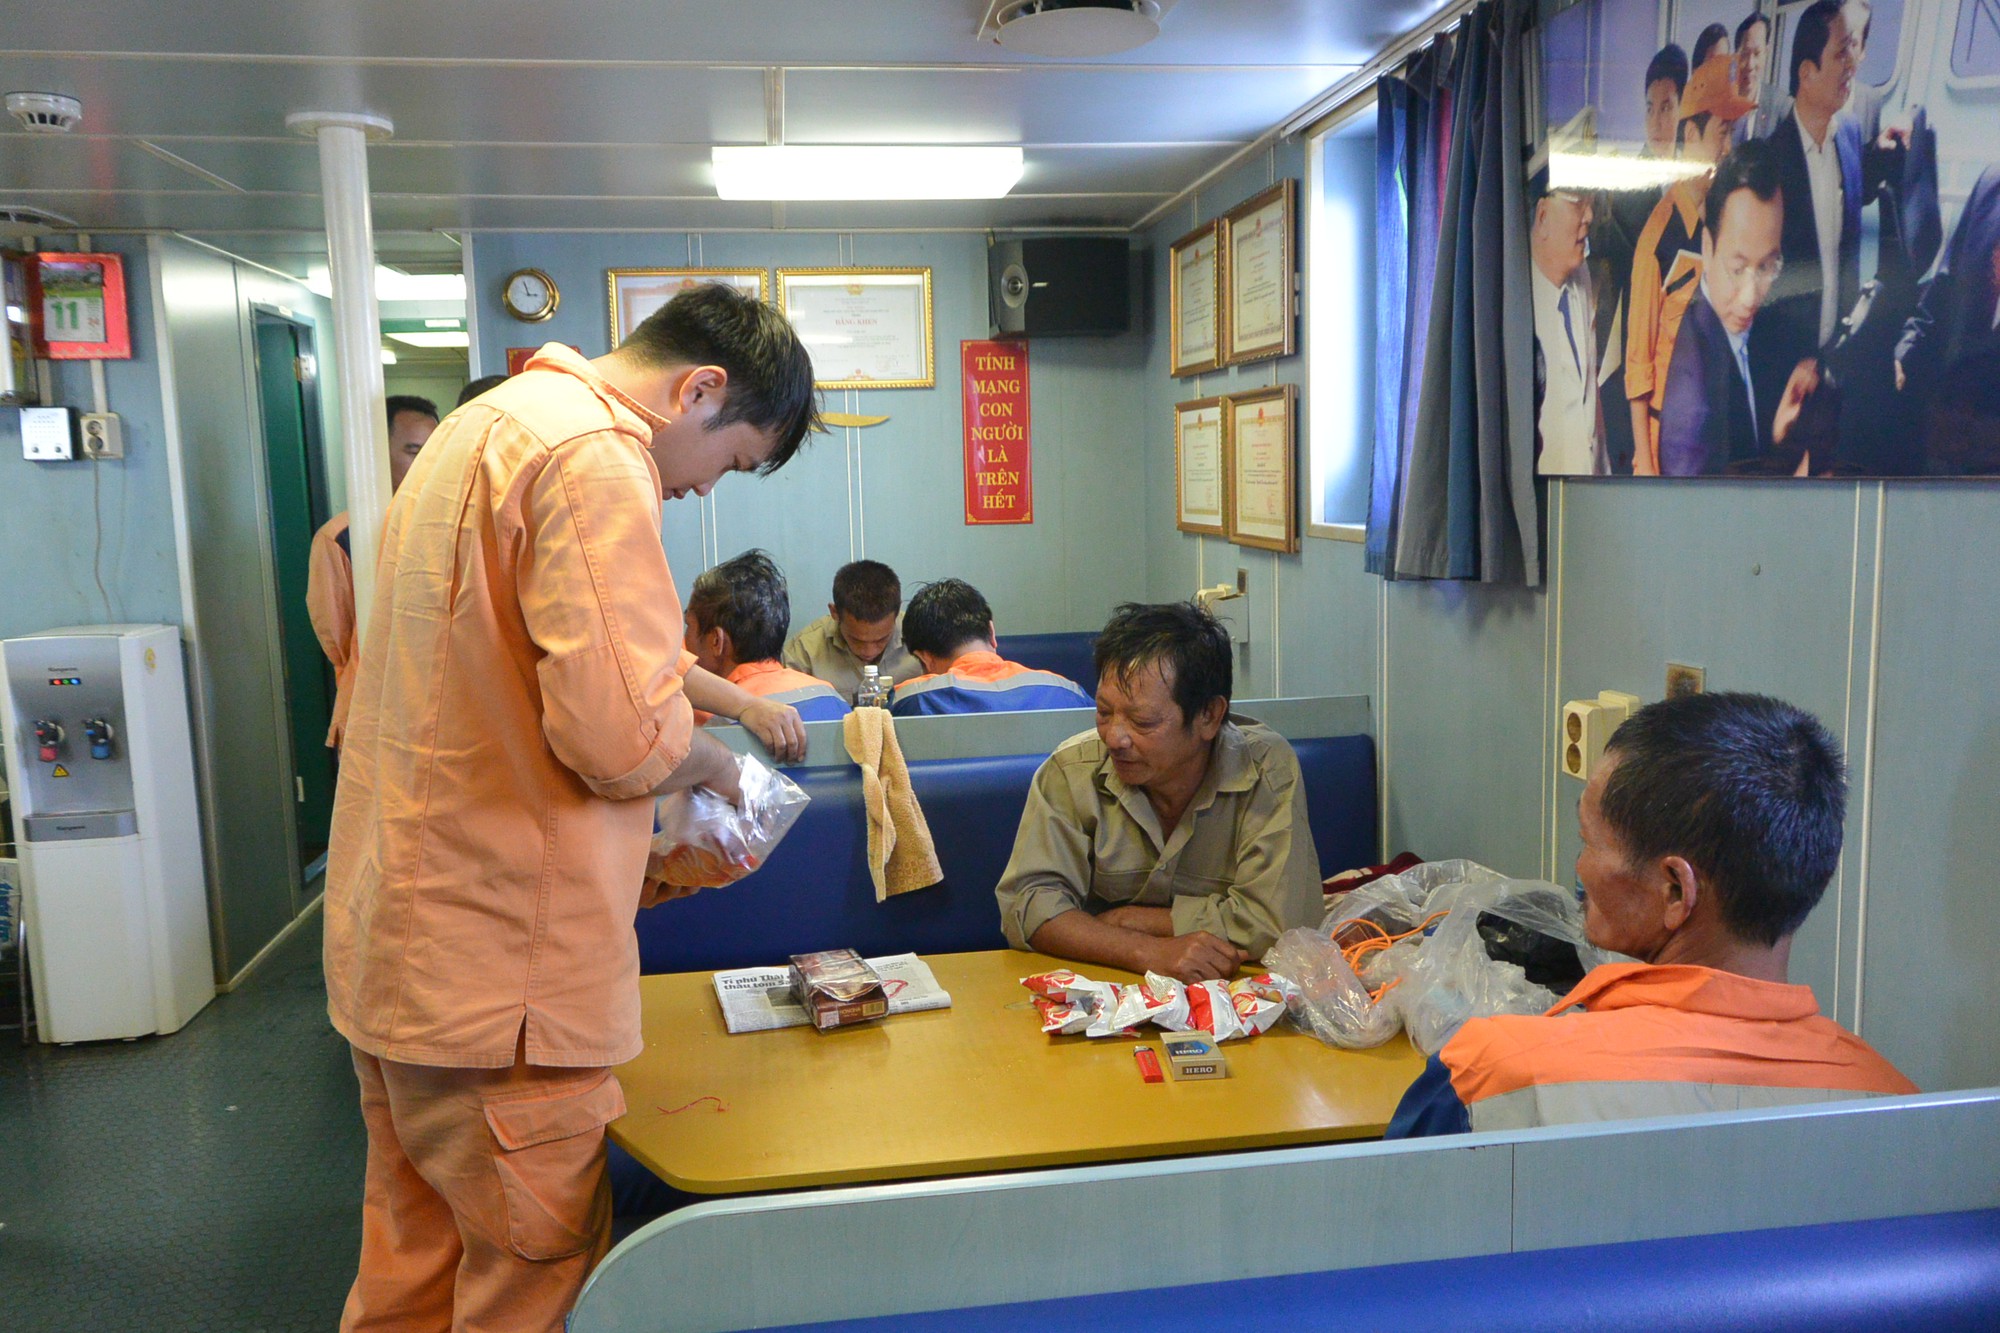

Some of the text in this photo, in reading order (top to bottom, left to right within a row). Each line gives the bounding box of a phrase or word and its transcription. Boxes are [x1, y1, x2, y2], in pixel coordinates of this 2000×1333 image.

[50, 301, 80, 330] 11
[975, 352, 1016, 371] TÍNH
[973, 379, 1021, 398] MẠNG
[979, 402, 1013, 417] CON
[971, 422, 1024, 441] NGƯỜI
[987, 445, 1009, 463] LÀ
[975, 469, 1020, 486] TRÊN
[982, 489, 1016, 509] HẾT
[1185, 1066, 1213, 1074] HERO
